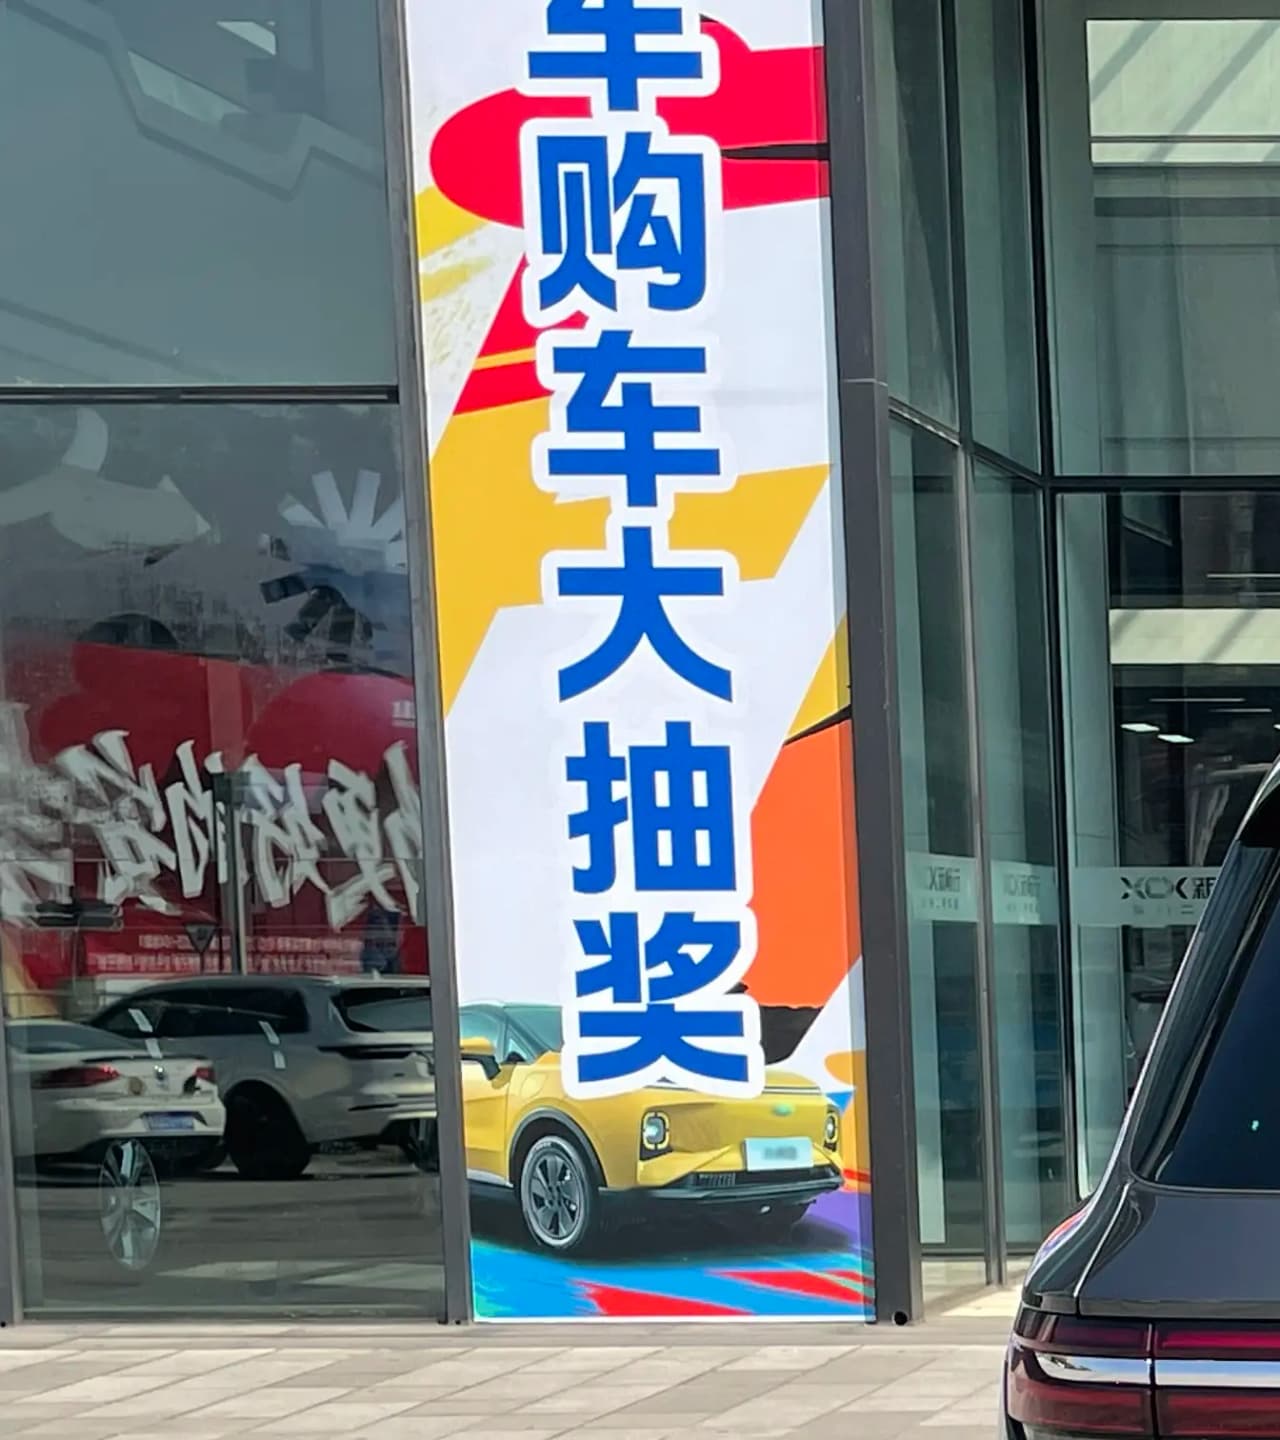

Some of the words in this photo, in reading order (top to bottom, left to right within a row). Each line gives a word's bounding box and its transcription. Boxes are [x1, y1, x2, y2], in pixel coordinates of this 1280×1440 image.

[528, 0, 748, 1084] 车购车大抽奖
